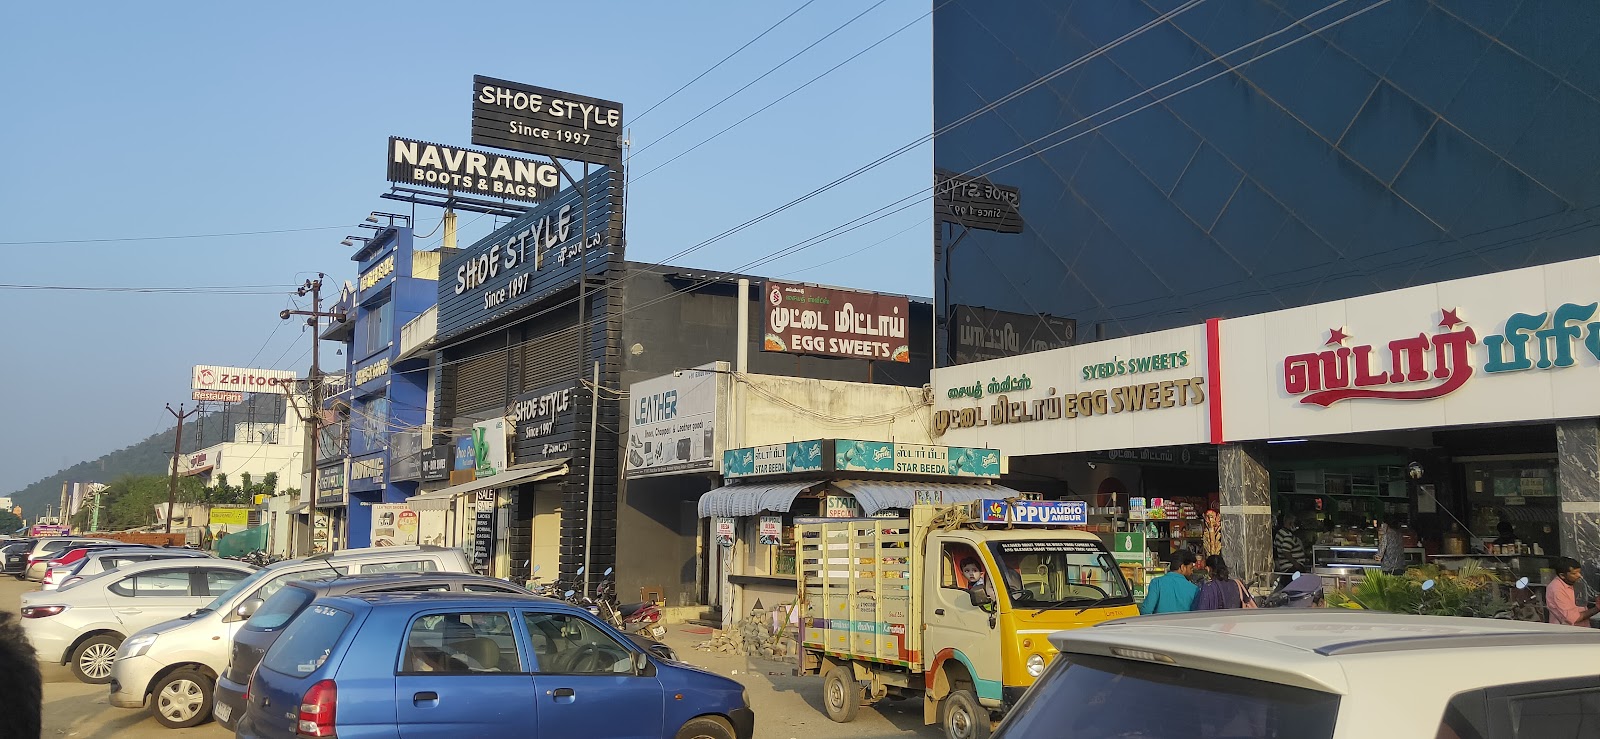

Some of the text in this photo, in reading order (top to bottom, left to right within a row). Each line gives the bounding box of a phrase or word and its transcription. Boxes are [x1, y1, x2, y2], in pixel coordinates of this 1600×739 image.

[478, 85, 620, 131] SHOE STYLE
[509, 120, 591, 146] Since 1997
[394, 139, 559, 187] NAVRANG
[413, 168, 537, 198] BOOTS & BAGS
[454, 245, 500, 295] SHOE
[504, 204, 572, 272] STYLE
[483, 272, 529, 310] Since 1997
[770, 302, 905, 339] முட்டை மிட்டாய்
[791, 334, 890, 358] EGG SWEETS
[1284, 307, 1478, 408] ஸ்டார்
[1082, 350, 1188, 381] SYED'S SWEETS
[947, 373, 1032, 399] சையத் ஸ்வீட்ஸ்
[514, 388, 569, 423] SHOE STYLE
[634, 390, 678, 425] LEATHER
[933, 377, 1205, 437] முட்டை மிட்டாய் EGG SWEETS
[525, 422, 553, 439] Since 1997
[755, 463, 785, 474] STAR BEEDA
[896, 462, 947, 474] STAR BEEDA
[478, 489, 493, 500] SALE
[478, 501, 492, 511] SALE
[828, 496, 857, 509] STAR
[829, 509, 855, 517] SPECIAL
[1004, 506, 1050, 523] APPU
[1050, 507, 1082, 515] AUDIO
